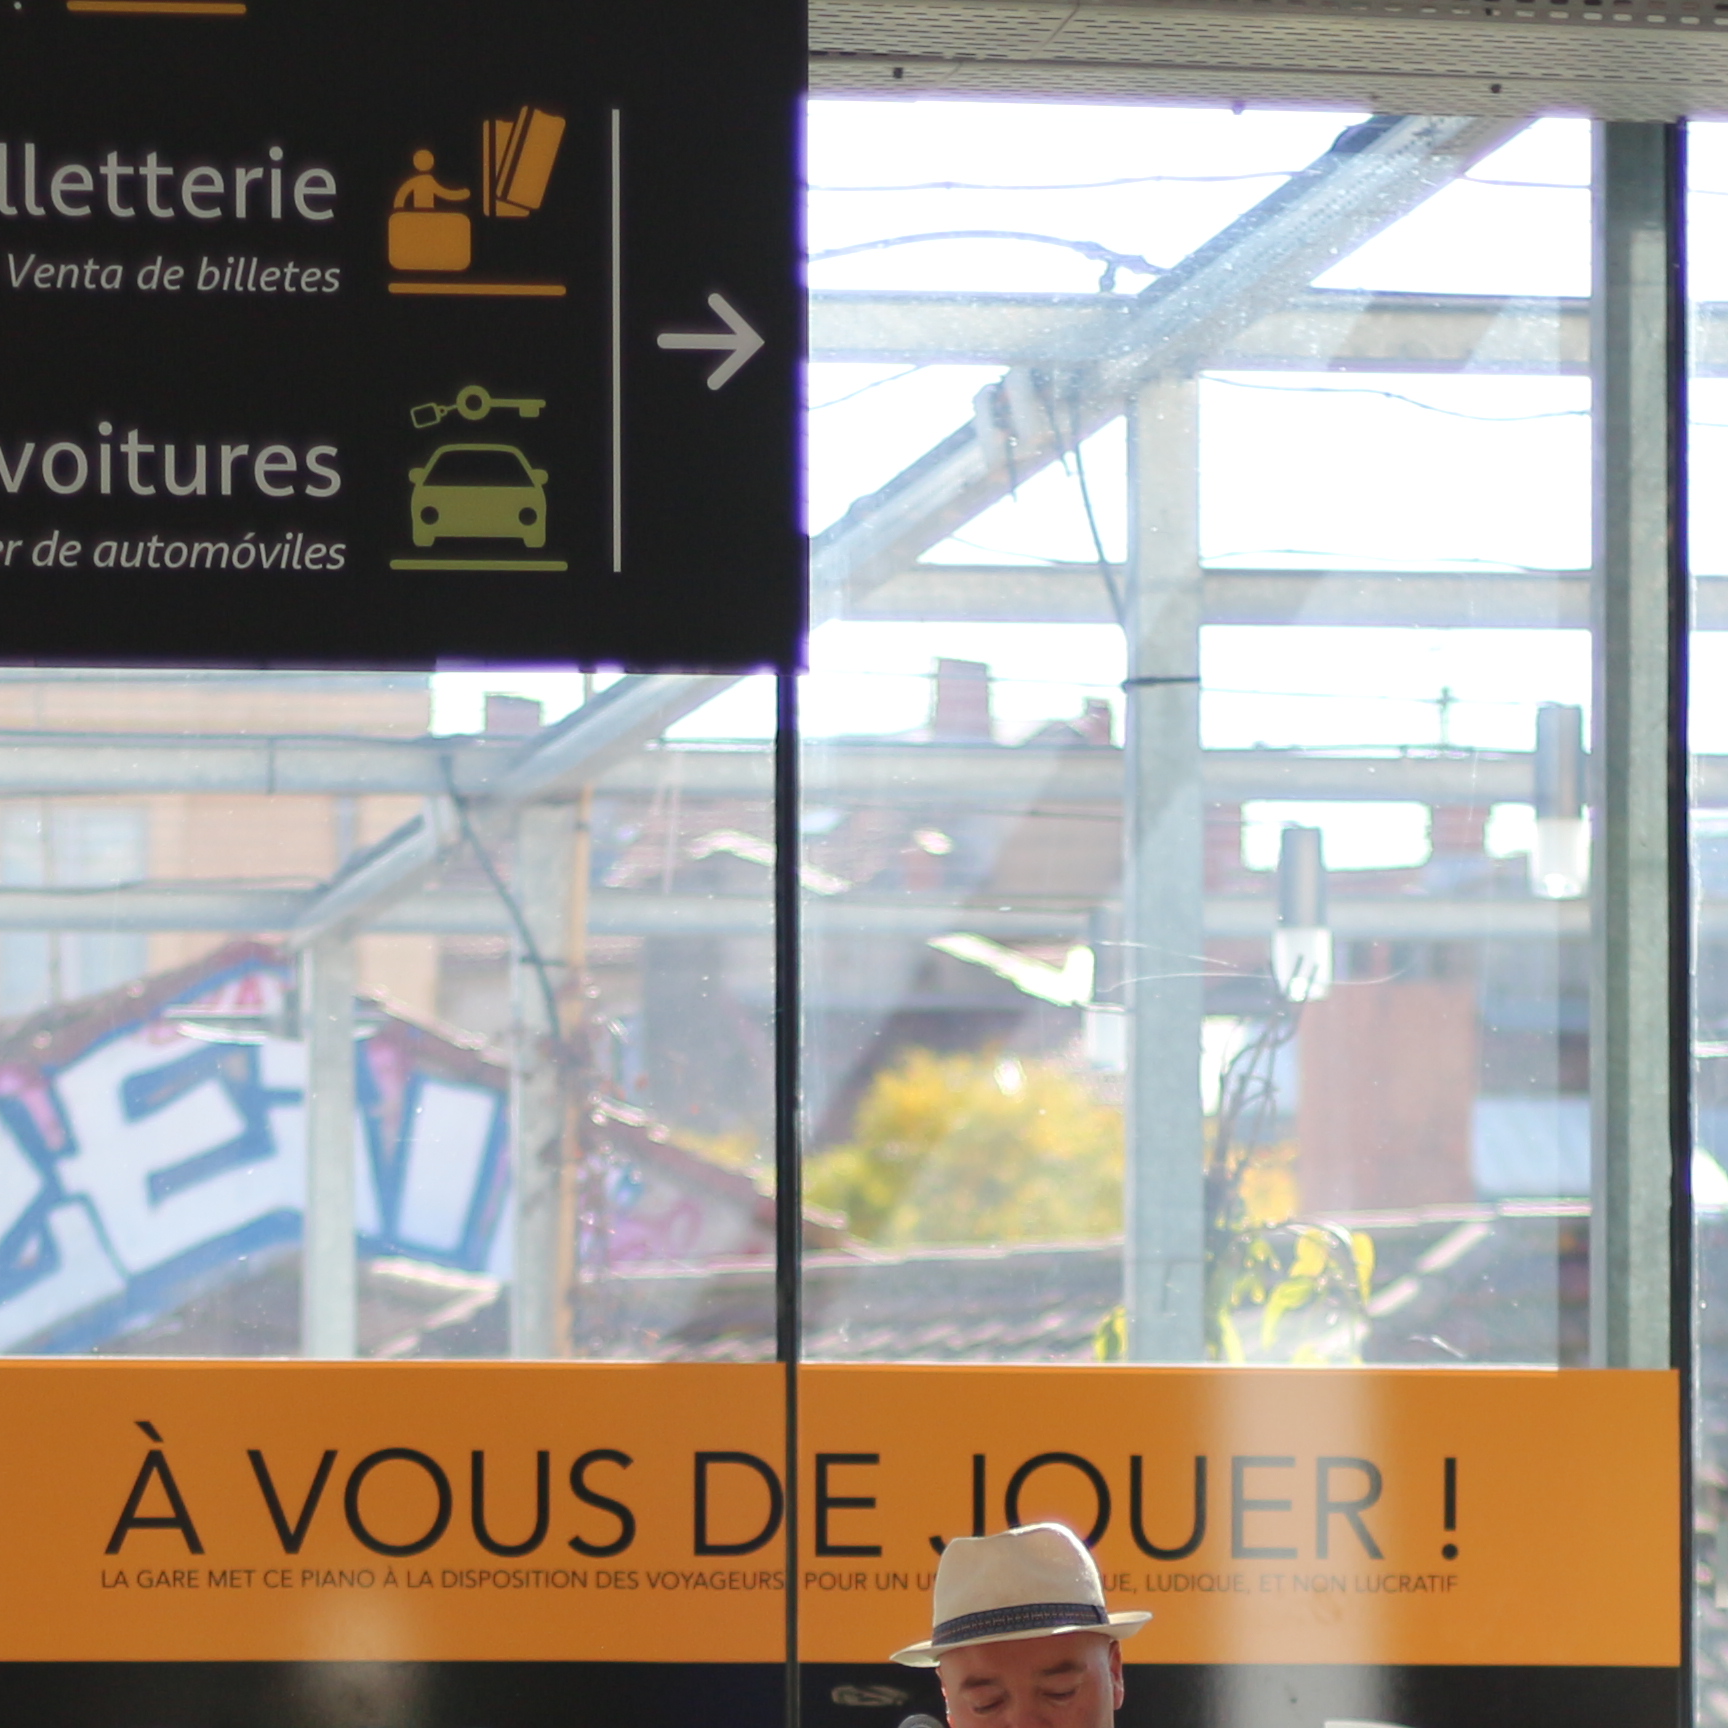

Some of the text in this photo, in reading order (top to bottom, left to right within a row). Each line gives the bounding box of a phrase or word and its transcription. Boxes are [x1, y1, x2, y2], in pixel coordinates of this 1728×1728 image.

[8, 254, 125, 291] Venta
[137, 256, 186, 292] de
[197, 257, 342, 294] billetes
[32, 530, 83, 569] de
[93, 530, 348, 571] automóviles
[105, 1421, 1460, 1561] À VOUS DE JOUER !
[101, 1569, 130, 1590] LA
[136, 1569, 200, 1591] GARE
[208, 1569, 257, 1591] MET
[263, 1569, 294, 1591] CE
[301, 1569, 377, 1590] PIANO
[383, 1564, 400, 1589] À
[407, 1570, 435, 1590] LA
[441, 1569, 589, 1591] DISPOSITION
[596, 1570, 639, 1591] DES
[647, 1570, 785, 1592] VOYAGEURS
[804, 1571, 869, 1592] POUR
[875, 1571, 910, 1592] UN
[1146, 1572, 1252, 1597] LUDIQUE,
[1260, 1573, 1286, 1594] ET
[1293, 1573, 1348, 1595] NON
[1355, 1572, 1461, 1596] LUCRATIF
